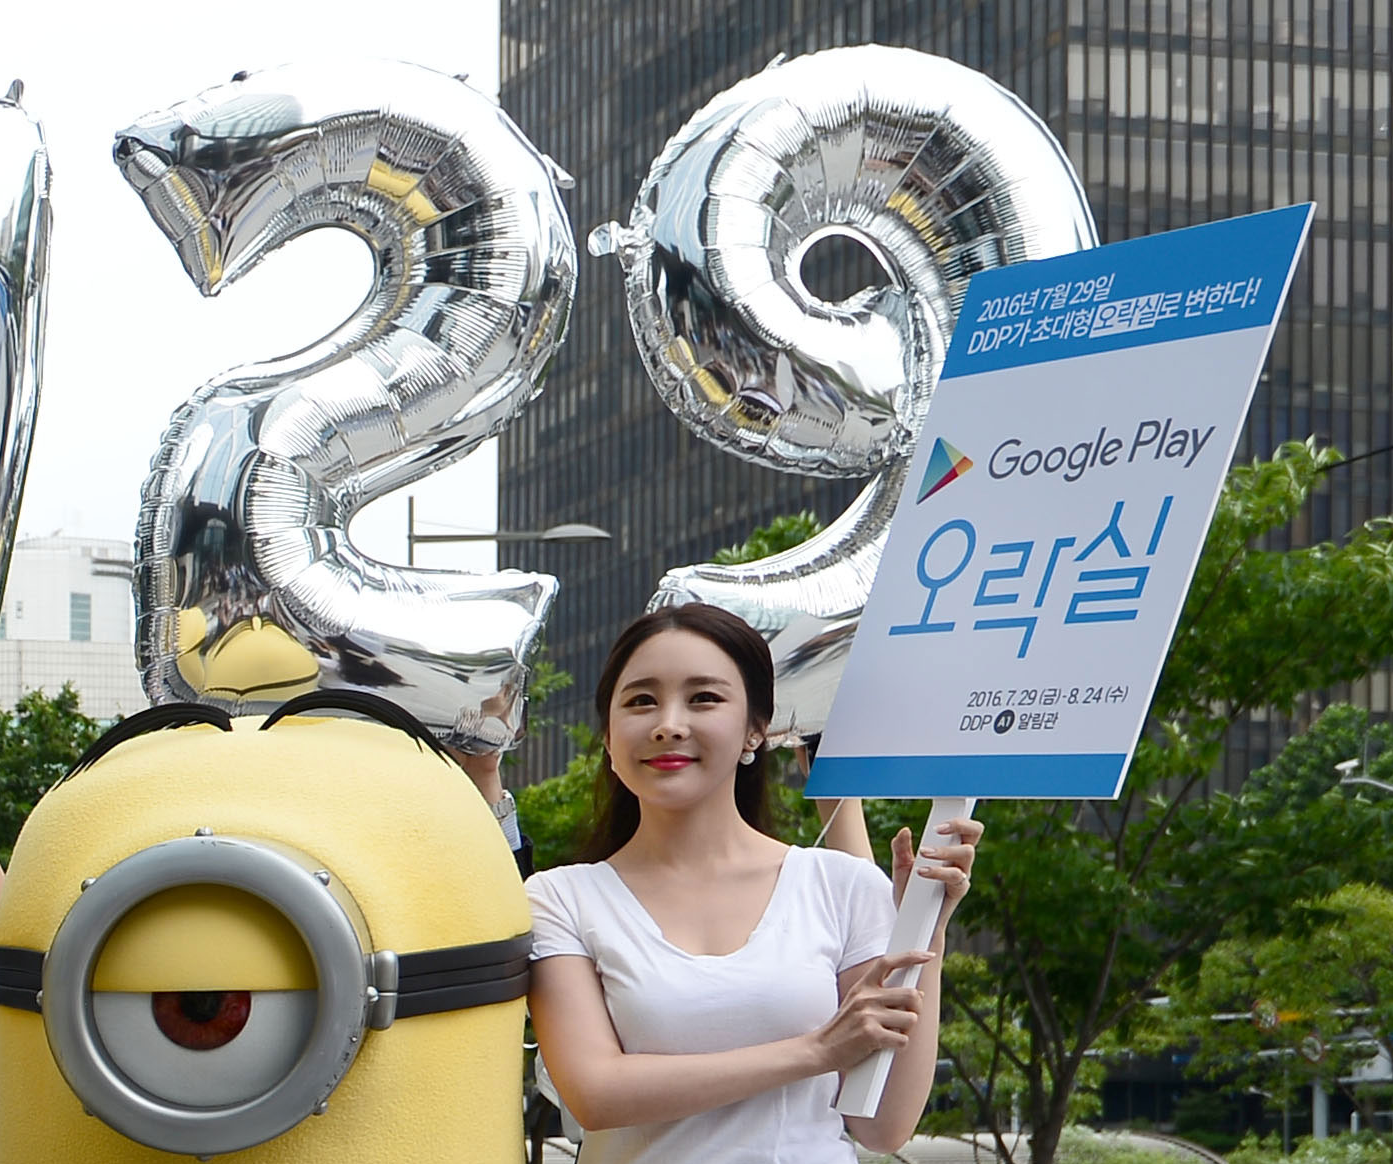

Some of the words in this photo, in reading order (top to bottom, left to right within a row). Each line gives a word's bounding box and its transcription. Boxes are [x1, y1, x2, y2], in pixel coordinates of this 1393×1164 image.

[966, 323, 1032, 355] DDP가
[1029, 307, 1096, 342] 초대형
[1184, 276, 1263, 318] 변한다!
[976, 287, 1040, 323] 2016년
[1042, 282, 1070, 311] 7월
[1070, 272, 1116, 303] 29일
[988, 426, 1123, 482] Google
[1127, 418, 1216, 468] Play
[888, 495, 1174, 658] 오락실
[959, 714, 992, 731] DDP
[1017, 712, 1059, 730] 알림관
[1105, 685, 1129, 704] (수)
